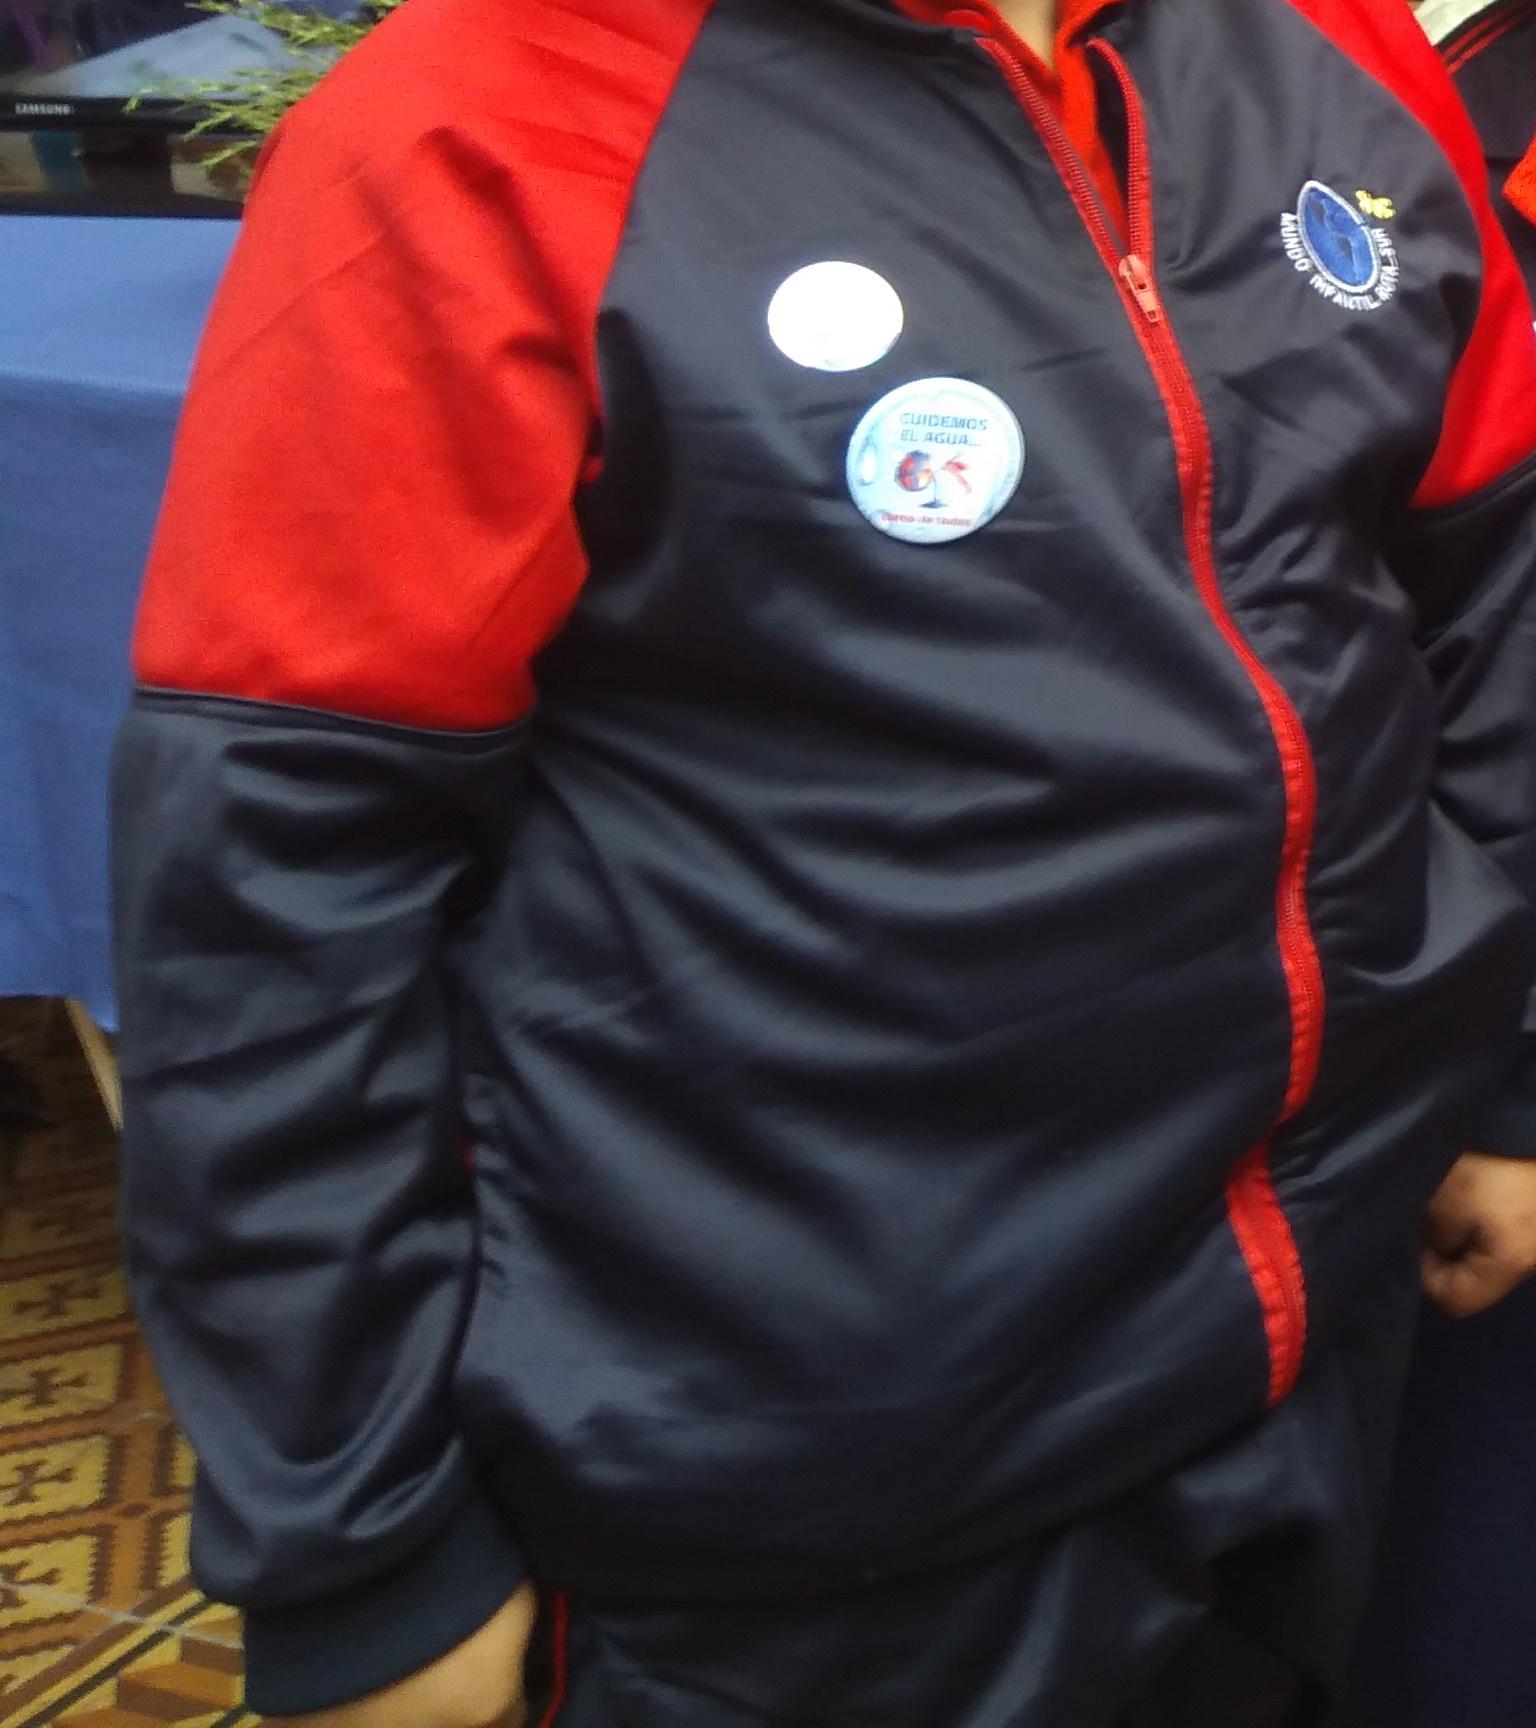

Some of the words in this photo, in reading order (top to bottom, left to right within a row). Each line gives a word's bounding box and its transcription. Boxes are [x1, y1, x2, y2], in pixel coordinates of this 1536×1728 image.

[1281, 213, 1312, 271] MUNDO
[900, 412, 989, 431] CUIDEMOS
[900, 429, 918, 443] EL
